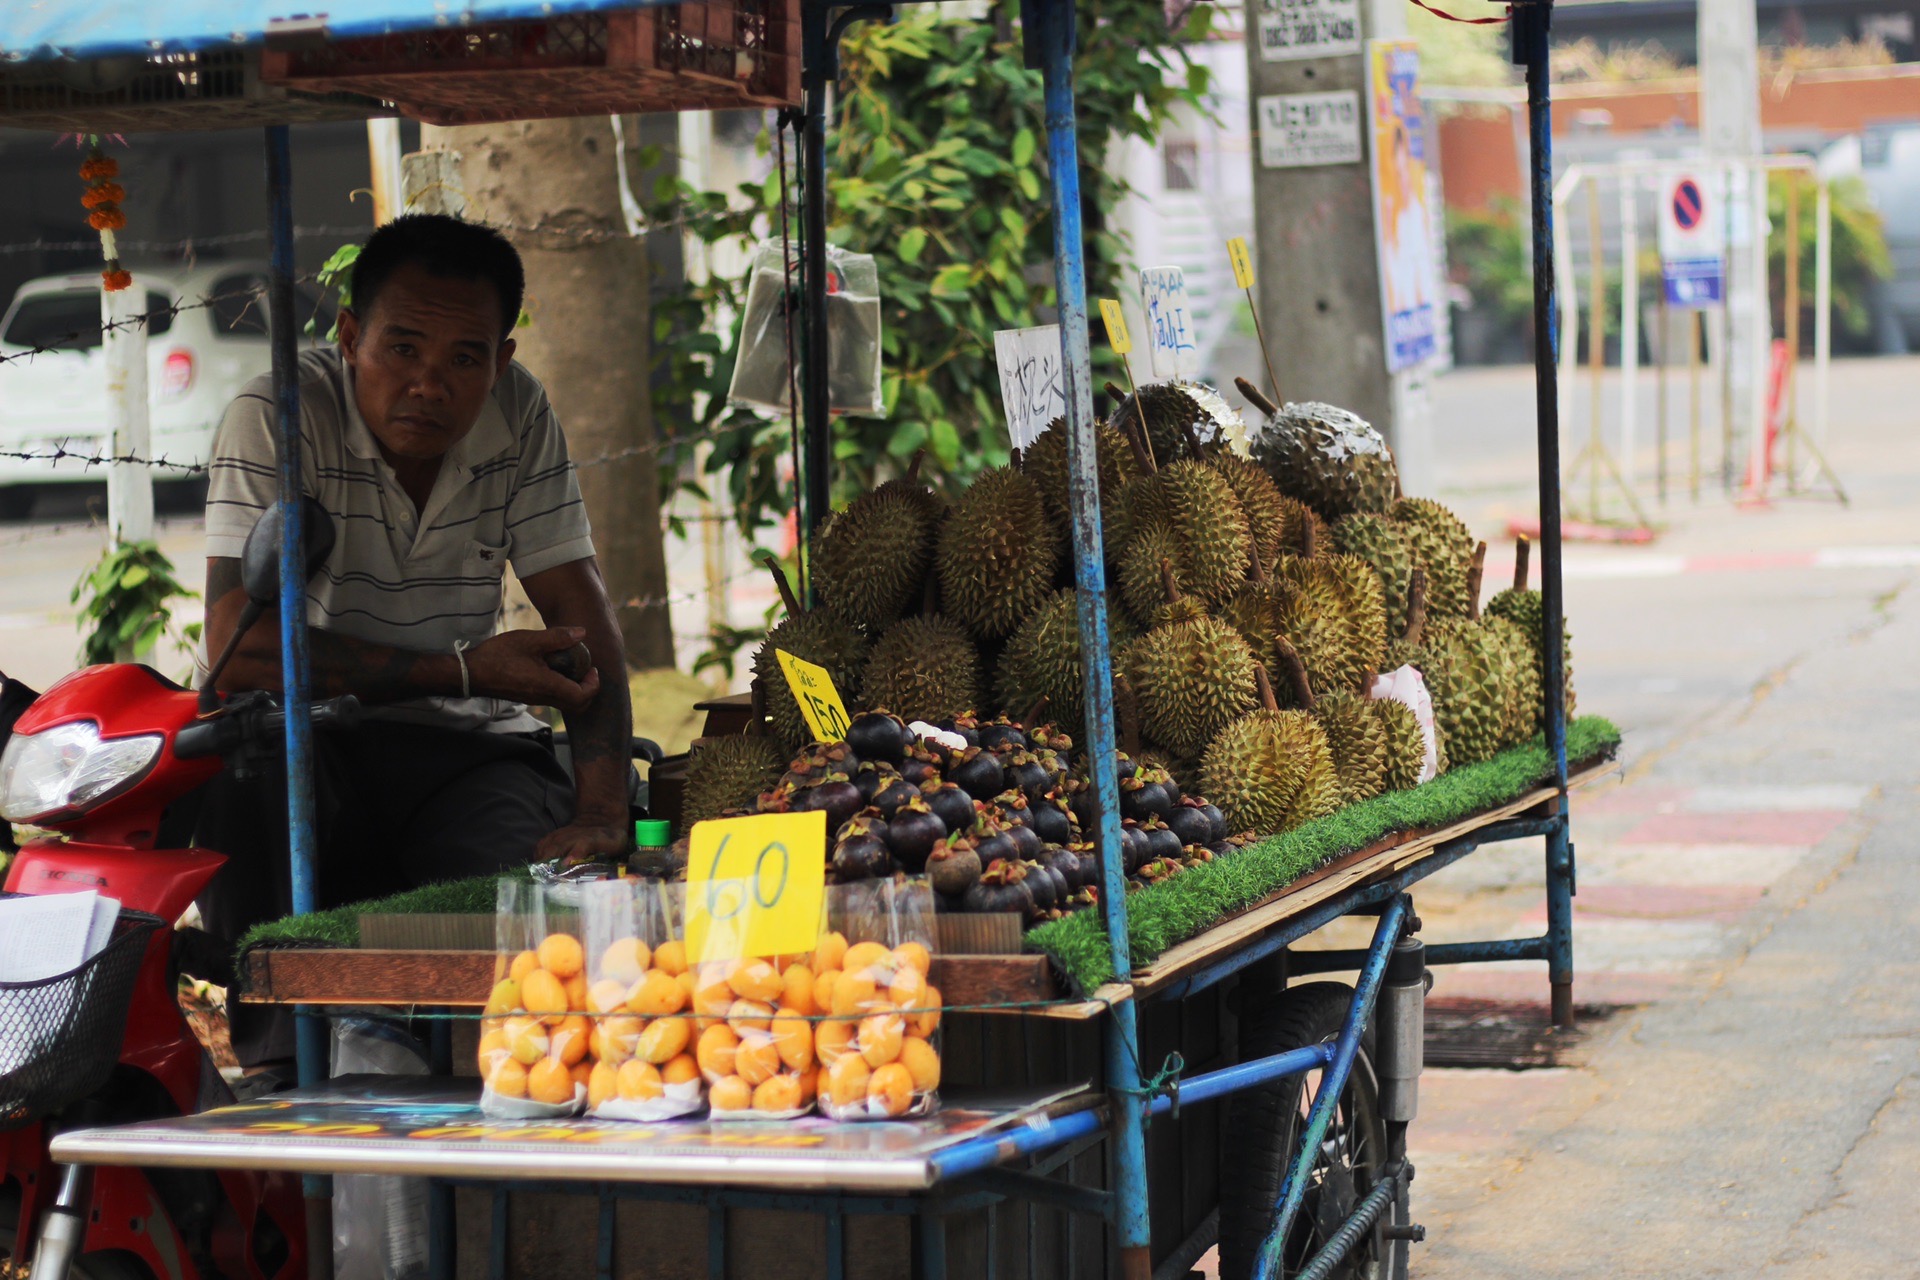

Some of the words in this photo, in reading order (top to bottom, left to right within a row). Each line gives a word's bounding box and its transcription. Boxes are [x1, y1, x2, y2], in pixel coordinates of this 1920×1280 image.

[803, 691, 848, 740] 150
[41, 870, 109, 887] HONDA
[705, 833, 789, 920] 60
